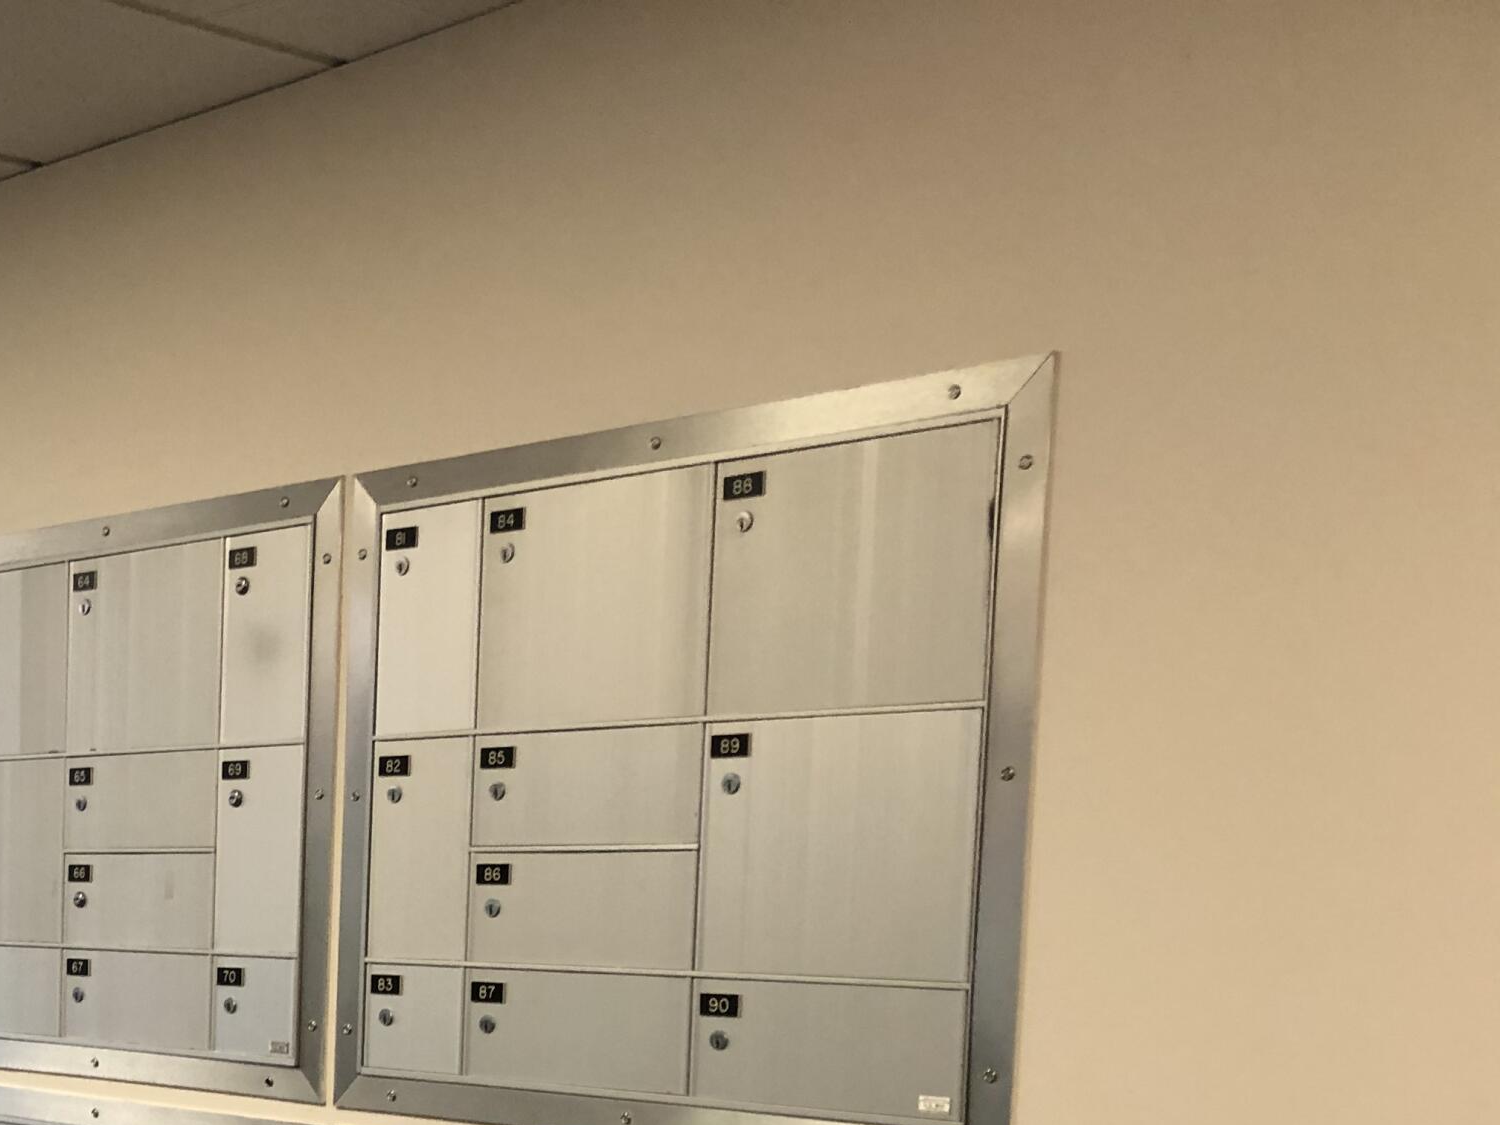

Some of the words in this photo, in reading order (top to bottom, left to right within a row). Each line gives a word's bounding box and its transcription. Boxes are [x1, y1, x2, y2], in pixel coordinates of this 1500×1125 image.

[732, 477, 753, 496] 88
[497, 512, 515, 529] 84
[395, 531, 407, 546] 81
[77, 575, 90, 588] 64
[719, 737, 740, 754] 89
[488, 750, 505, 765] 85
[227, 762, 242, 776] 69
[385, 758, 401, 773] 82
[483, 866, 501, 882] 86
[71, 961, 84, 974] 67
[222, 969, 237, 984] 70
[377, 977, 393, 992] 83
[478, 984, 496, 1000] 87
[708, 997, 730, 1014] 90
